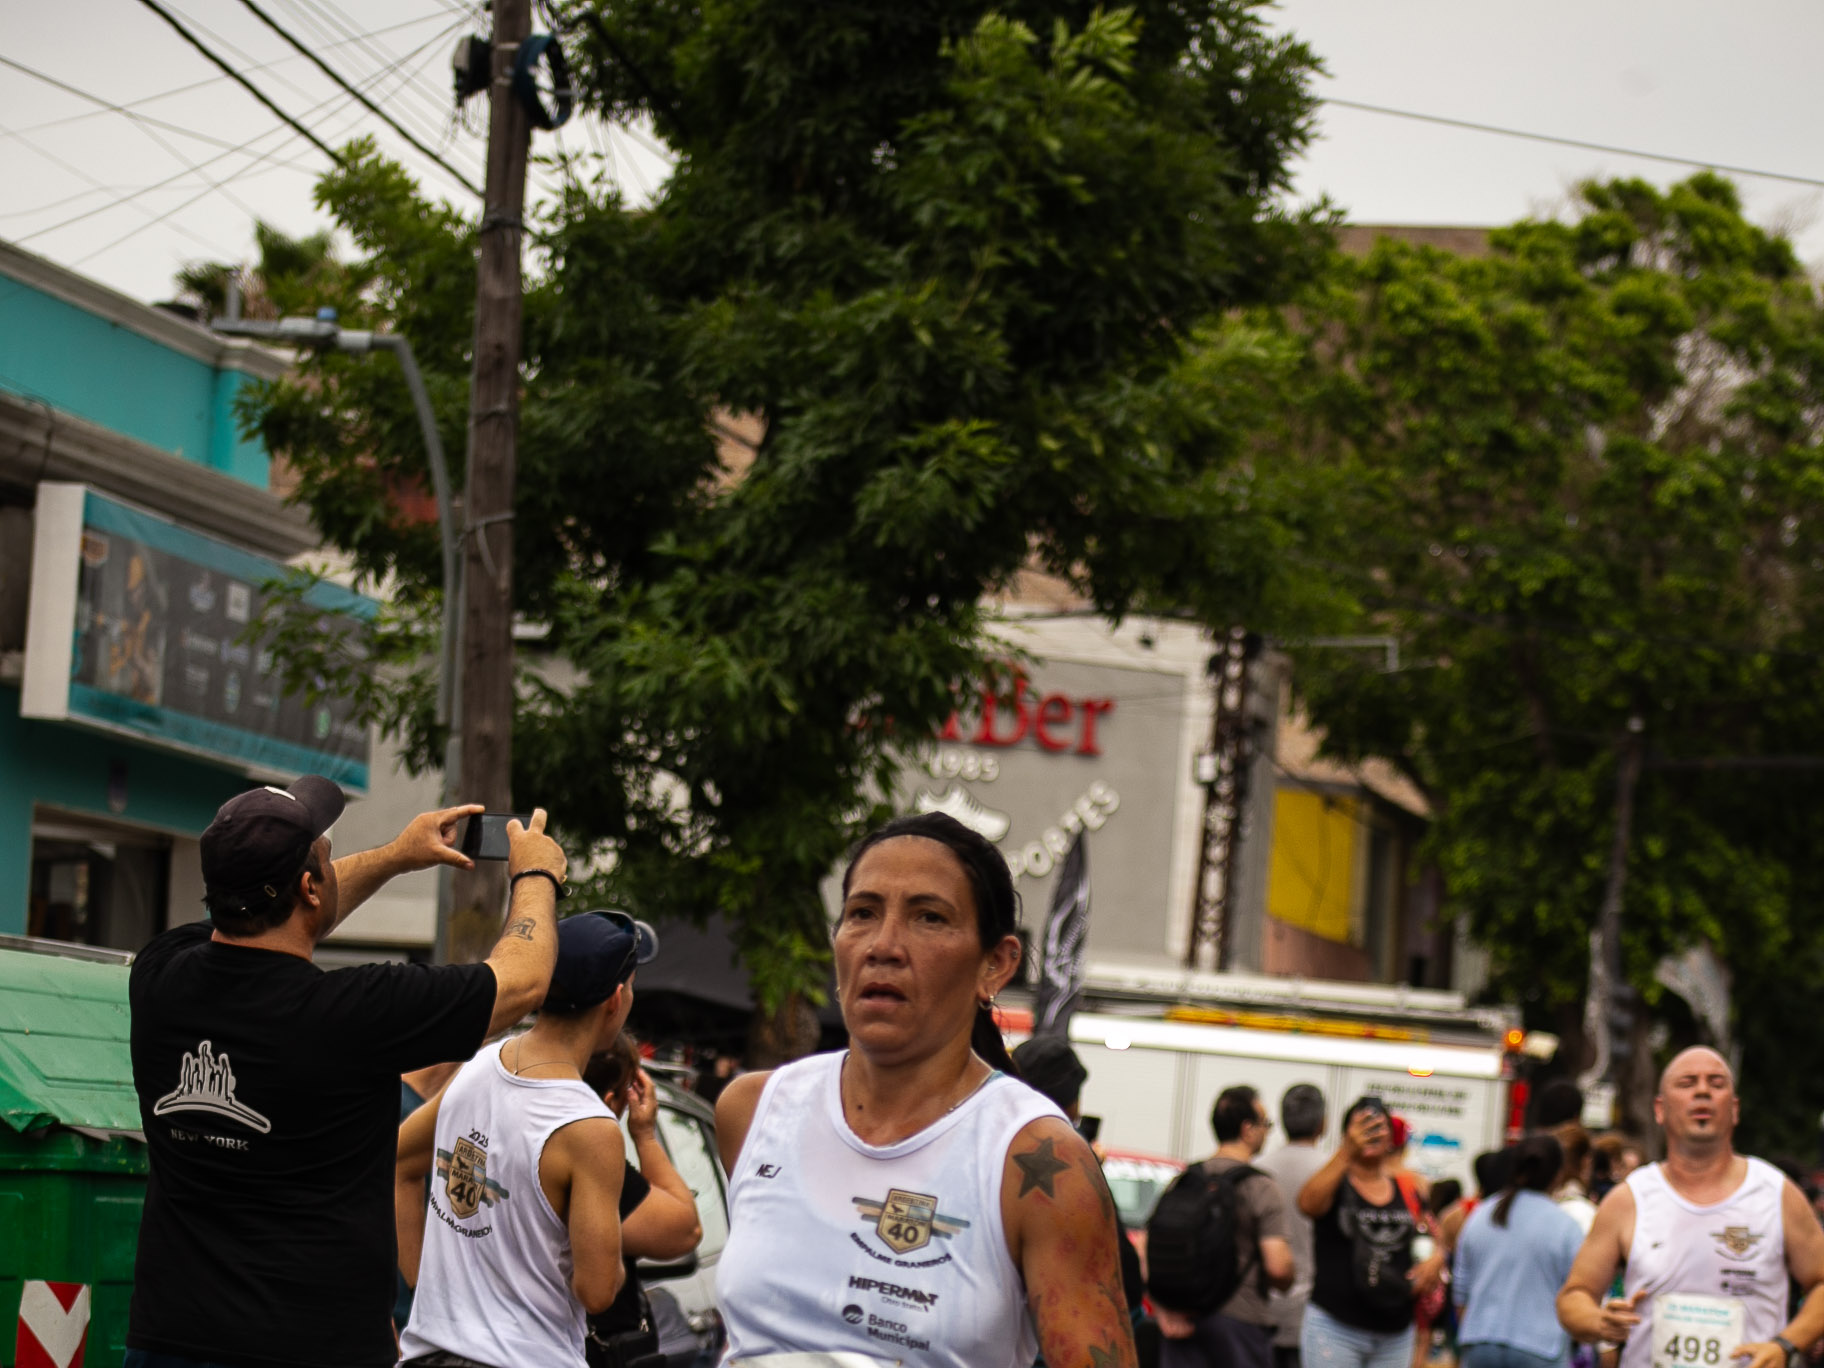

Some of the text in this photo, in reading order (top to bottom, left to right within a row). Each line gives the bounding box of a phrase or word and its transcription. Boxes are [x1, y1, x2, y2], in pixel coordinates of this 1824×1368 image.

[450, 1181, 476, 1208] 40
[887, 1222, 919, 1245] 40
[868, 1313, 907, 1334] Banco
[867, 1326, 930, 1351] Municipal
[1664, 1333, 1721, 1365] 498
